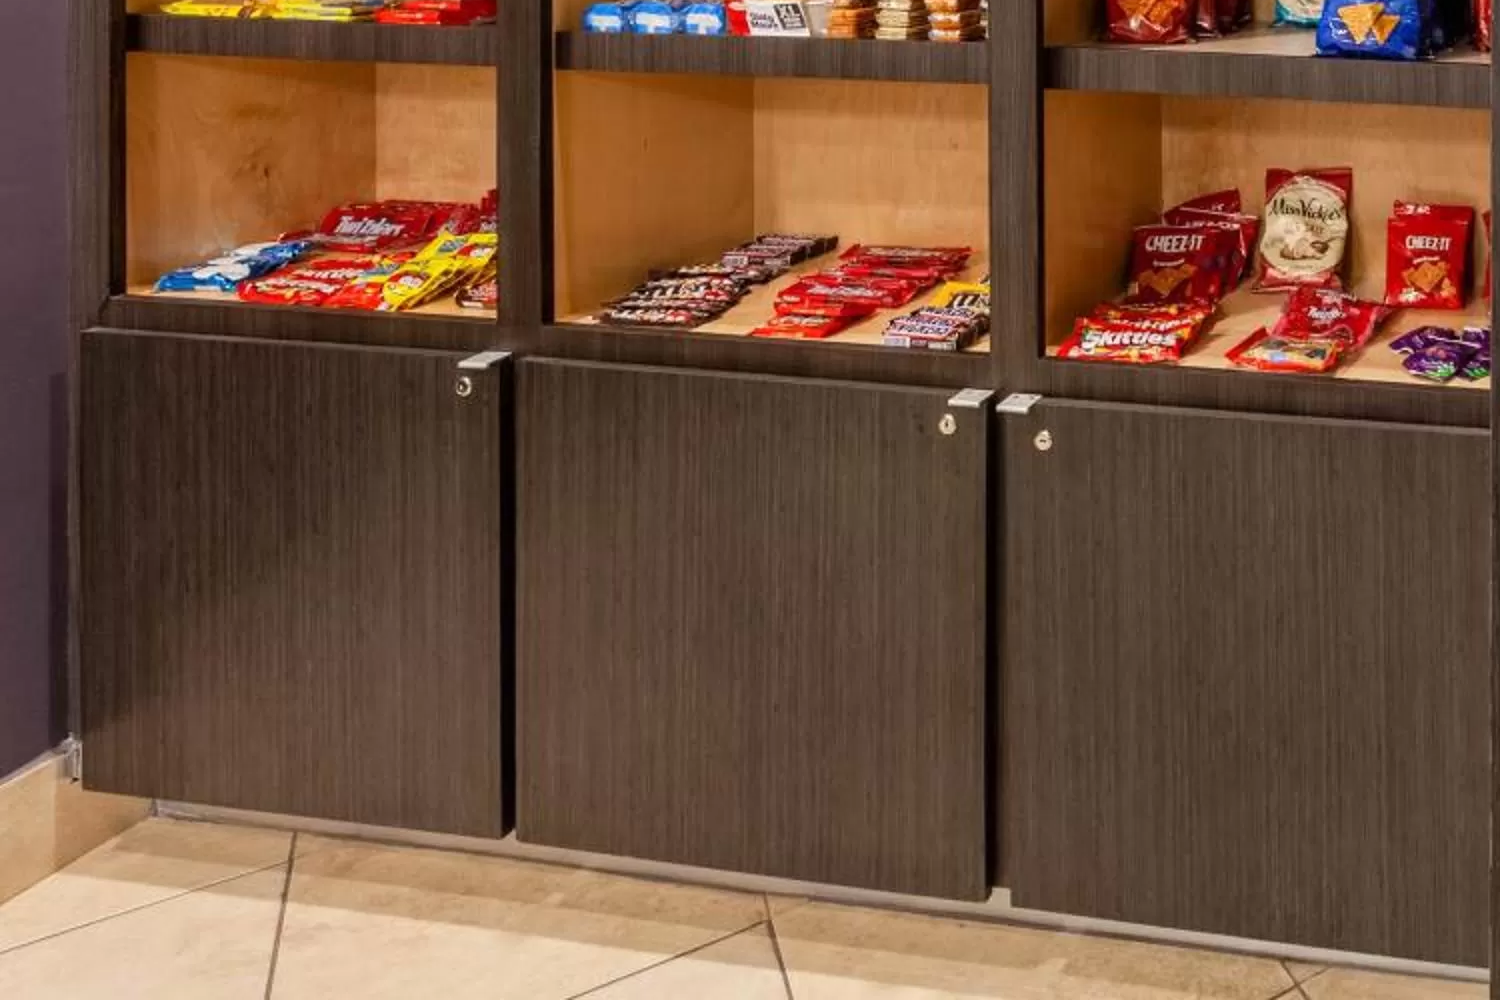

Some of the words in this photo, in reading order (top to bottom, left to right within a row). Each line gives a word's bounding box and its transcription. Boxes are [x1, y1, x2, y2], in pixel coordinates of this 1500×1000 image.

[1145, 234, 1206, 253] CHEEZ-IT
[1405, 235, 1452, 251] CHEEZ-IT
[1082, 328, 1178, 352] Skittles
